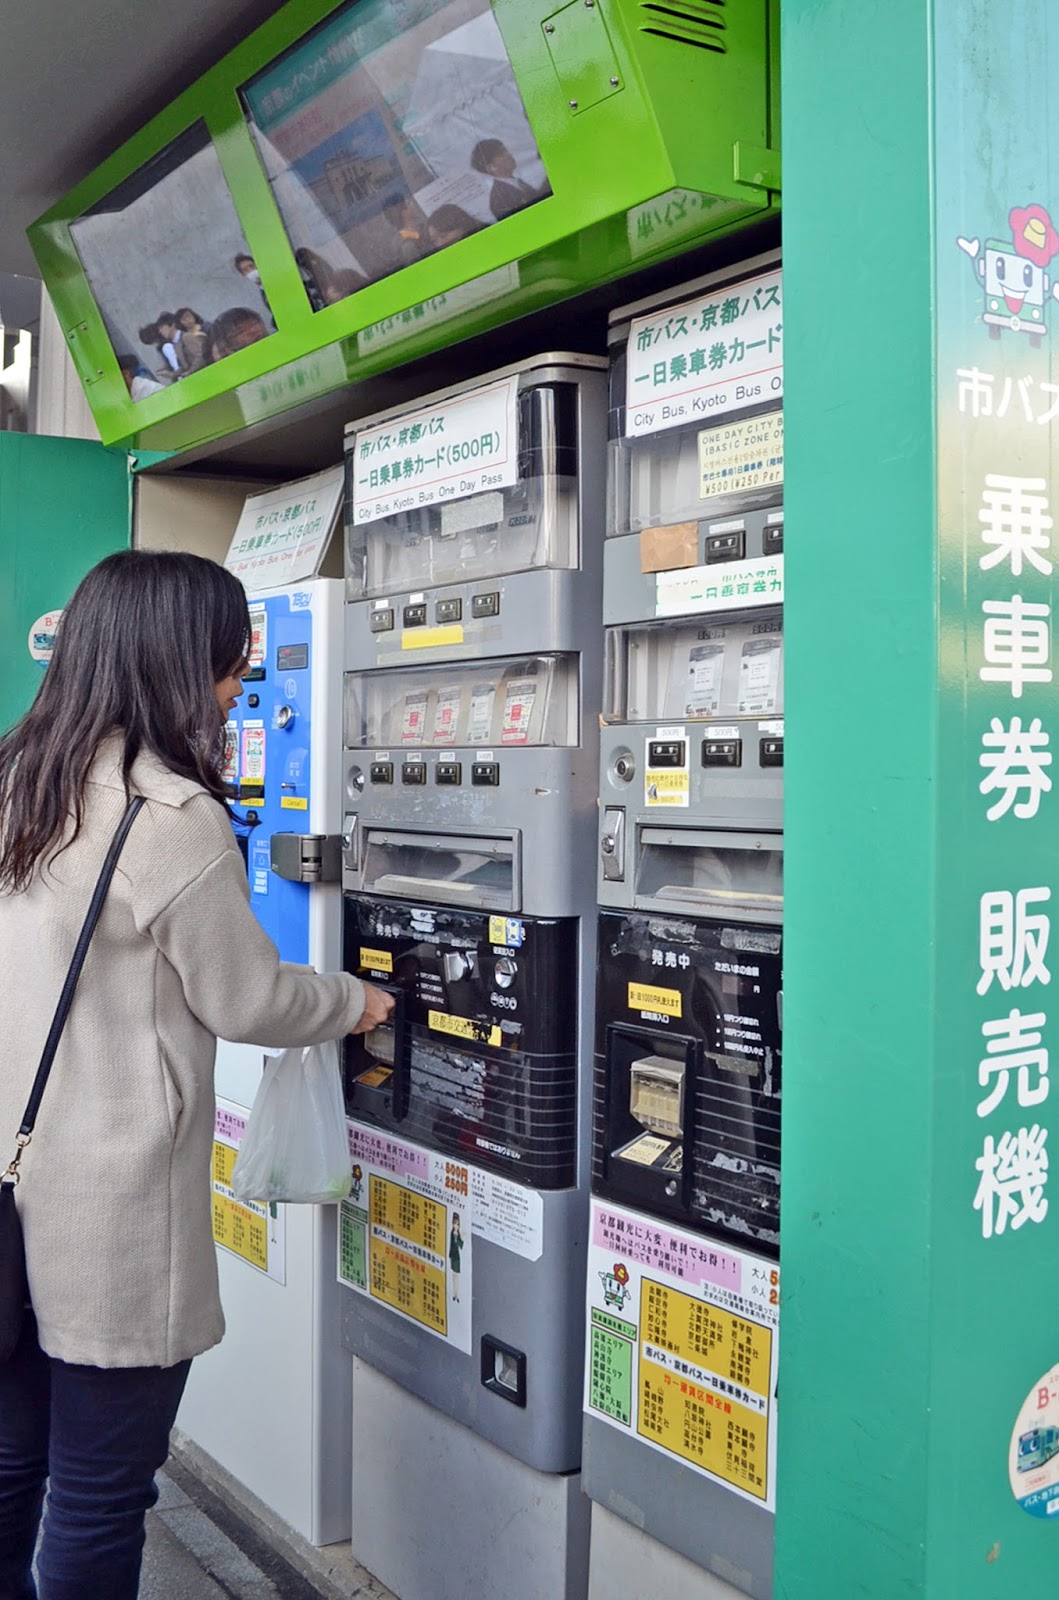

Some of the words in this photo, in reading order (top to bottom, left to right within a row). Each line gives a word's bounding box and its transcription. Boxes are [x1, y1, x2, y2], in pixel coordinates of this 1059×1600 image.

[637, 285, 781, 352] 市バス・京都バス
[634, 323, 782, 387] 一日乗車券カード
[634, 413, 655, 427] City
[662, 406, 688, 420] Bus,
[692, 394, 727, 414] Kyoto
[735, 385, 761, 400] Bus
[771, 376, 783, 391] O
[956, 366, 1059, 425] 市バス
[360, 417, 446, 461] 市バス・京都バス
[702, 433, 721, 445] ONE
[724, 427, 743, 440] DAY
[747, 419, 773, 433] CITY
[777, 417, 784, 426] B
[744, 432, 769, 446] ZONE
[359, 431, 501, 489] 一日乗車券カード(500円)
[359, 508, 372, 519] City
[393, 496, 415, 511] Kyoto
[418, 491, 434, 503] Bus
[438, 486, 455, 497] One
[460, 481, 476, 494] Day
[481, 473, 503, 486] Pass
[977, 473, 1054, 822] 乗車券
[652, 950, 691, 970] 発売中
[973, 886, 1052, 1240] 販売機
[445, 1161, 468, 1183] 500円
[445, 1178, 468, 1197] 250円
[751, 1285, 766, 1298] 小人
[752, 1267, 768, 1281] 大人
[646, 1346, 766, 1410] 市バス・京都バス一日乗車券カード
